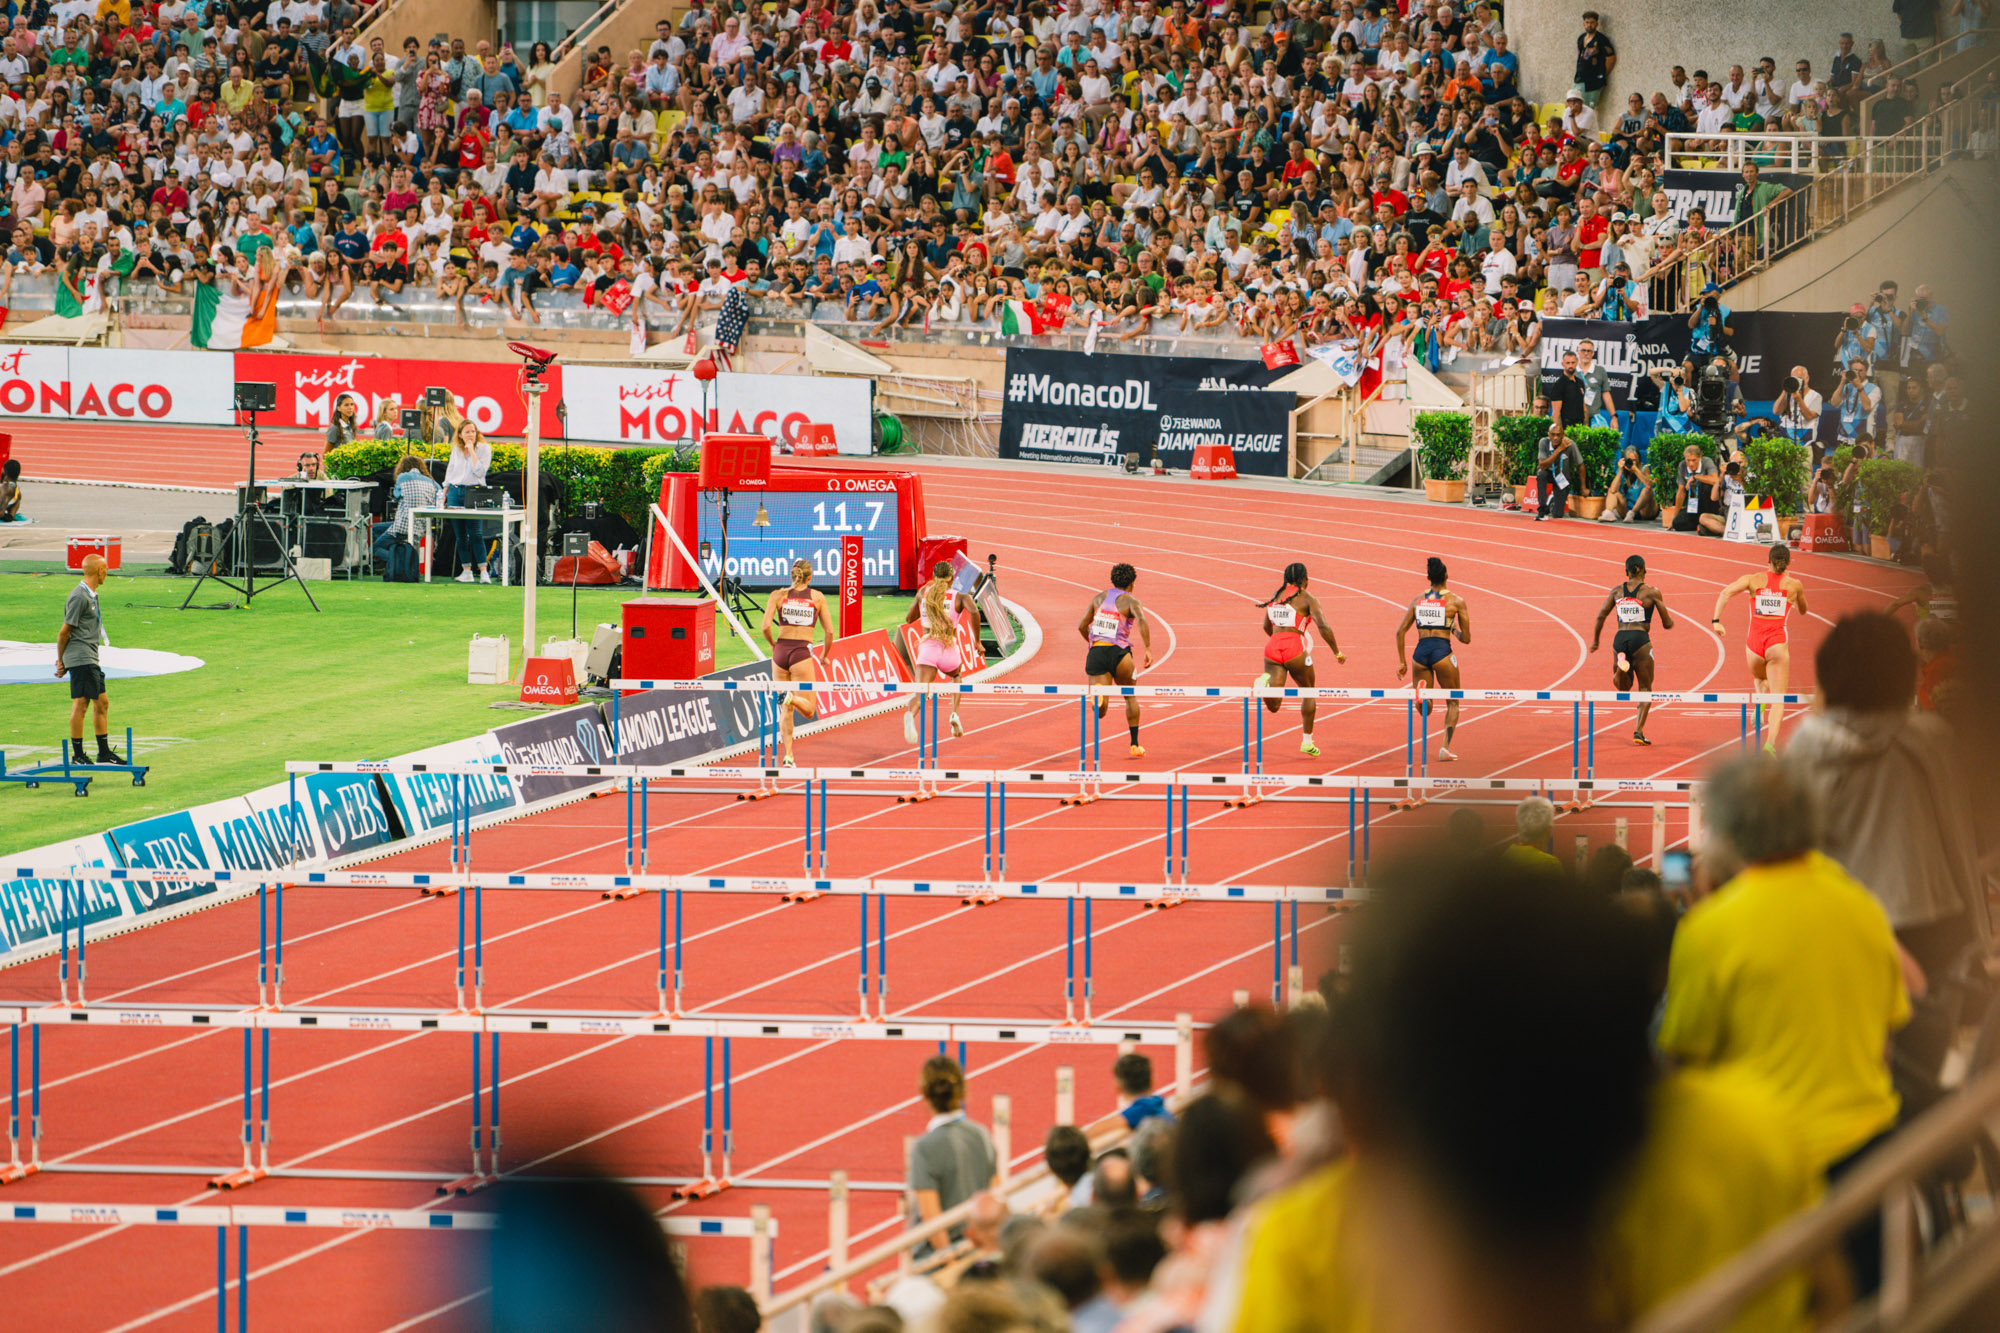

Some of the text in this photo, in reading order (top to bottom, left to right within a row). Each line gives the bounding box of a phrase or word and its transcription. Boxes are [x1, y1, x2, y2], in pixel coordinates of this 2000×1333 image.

[295, 358, 365, 389] visit
[619, 373, 683, 402] visit
[1008, 373, 1158, 411] #MonacoDL
[1158, 432, 1282, 452] DIAMOND LEAGUE
[1212, 464, 1235, 473] OMEGA
[845, 479, 897, 492] OMEGA
[812, 501, 885, 532] 11.7
[1814, 536, 1845, 544] OMEGA
[813, 549, 895, 576] 10mH
[846, 557, 858, 606] OMEGA
[782, 607, 813, 618] CARMASSI
[1761, 598, 1782, 608] VISSER
[1273, 610, 1290, 618] STARK
[1419, 609, 1442, 618] RUSSELL
[698, 648, 712, 662] OMEGA
[832, 644, 904, 708] OMEGA
[523, 685, 561, 695] OMEGA
[661, 696, 717, 742] LEAGUE
[336, 779, 390, 841] EBS
